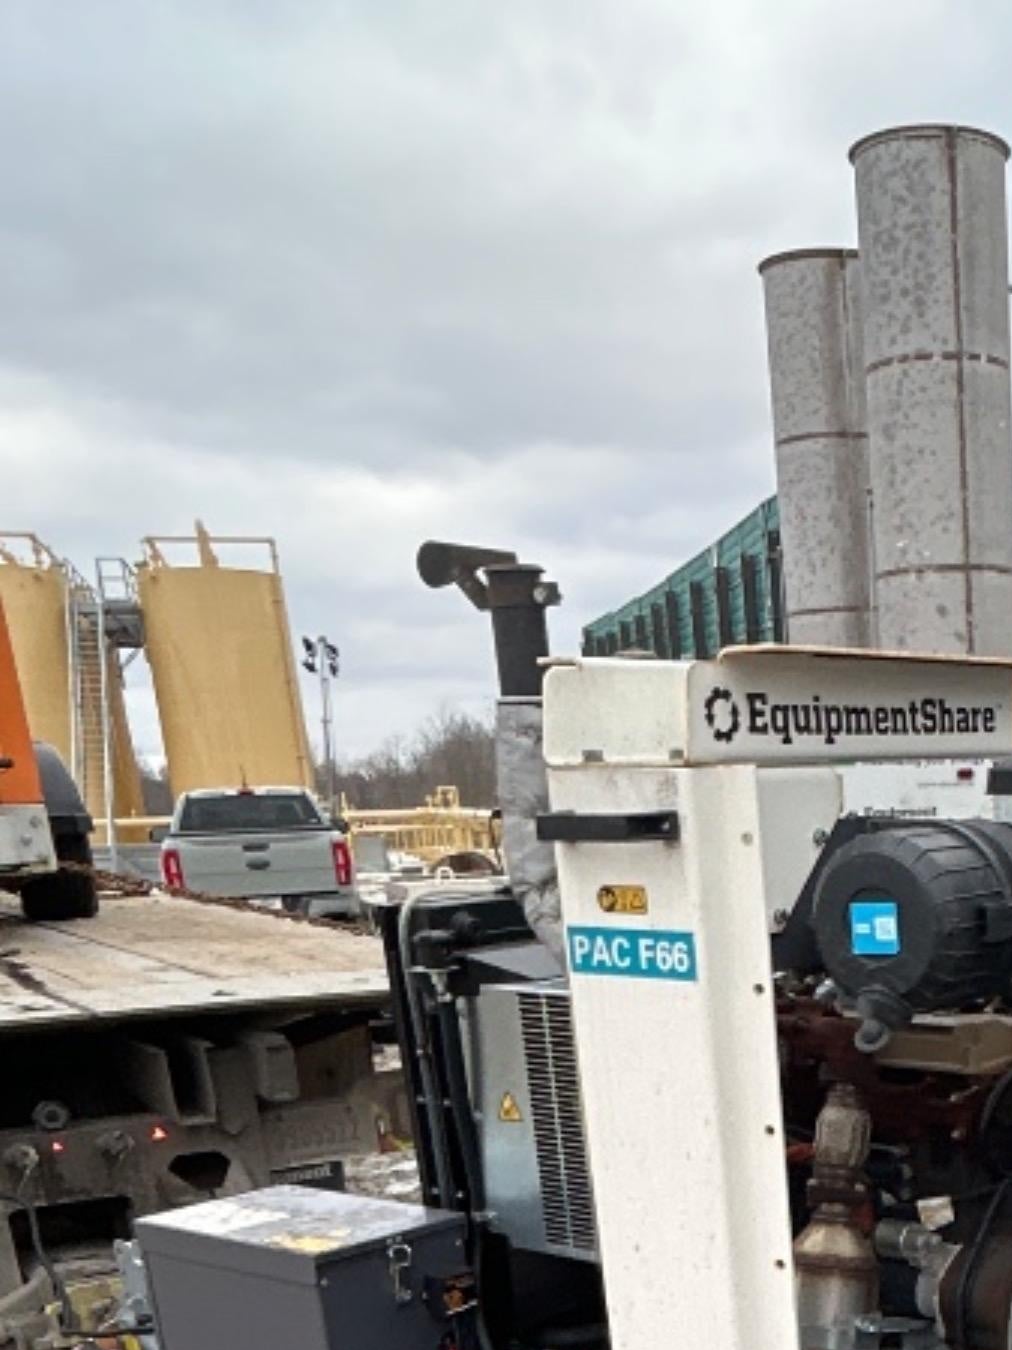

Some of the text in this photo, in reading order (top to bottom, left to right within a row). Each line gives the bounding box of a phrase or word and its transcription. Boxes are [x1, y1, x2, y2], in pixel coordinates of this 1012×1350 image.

[745, 692, 997, 745] EquipmentShare
[571, 934, 691, 974] PAC F66
